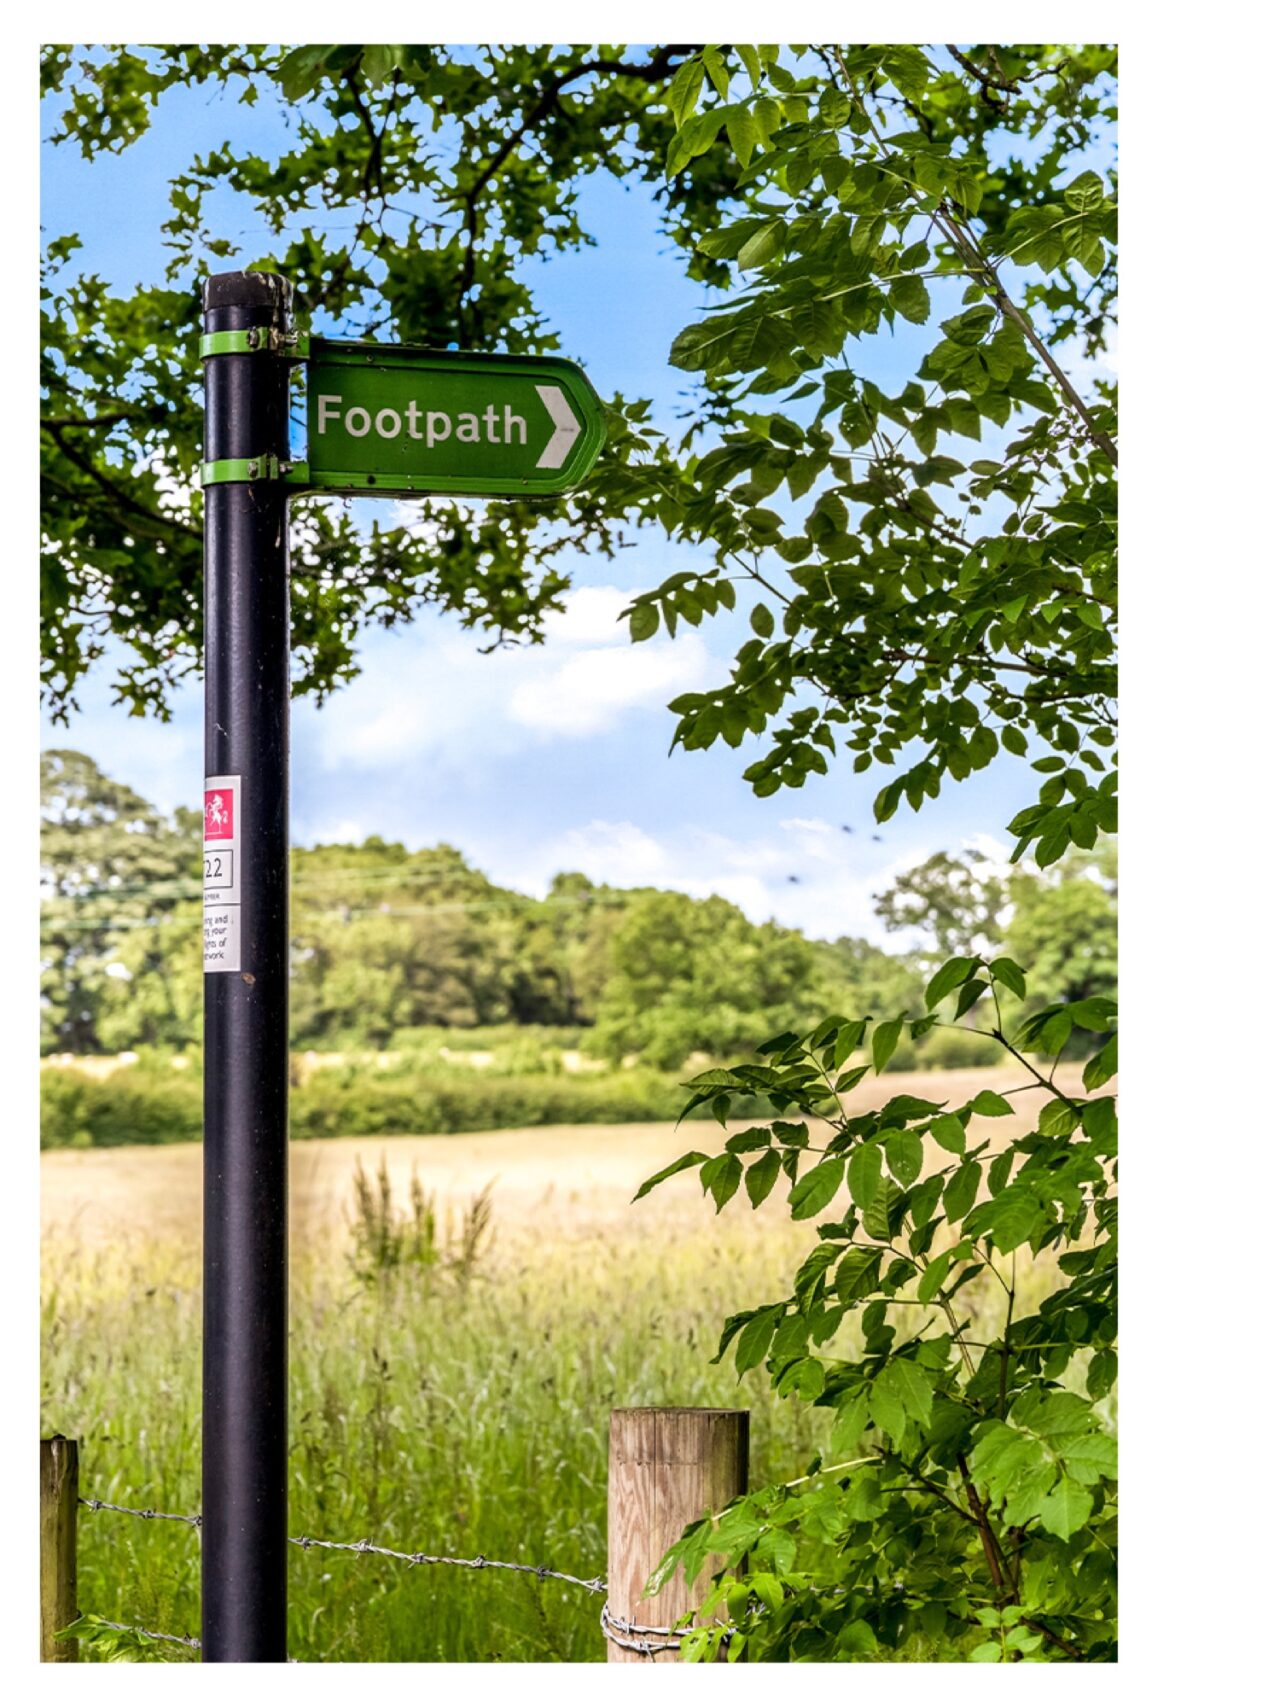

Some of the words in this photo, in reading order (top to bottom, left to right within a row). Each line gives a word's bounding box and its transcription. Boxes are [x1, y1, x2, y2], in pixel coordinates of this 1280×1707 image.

[317, 394, 528, 448] Footpath
[204, 857, 223, 878] 22
[214, 914, 228, 924] and
